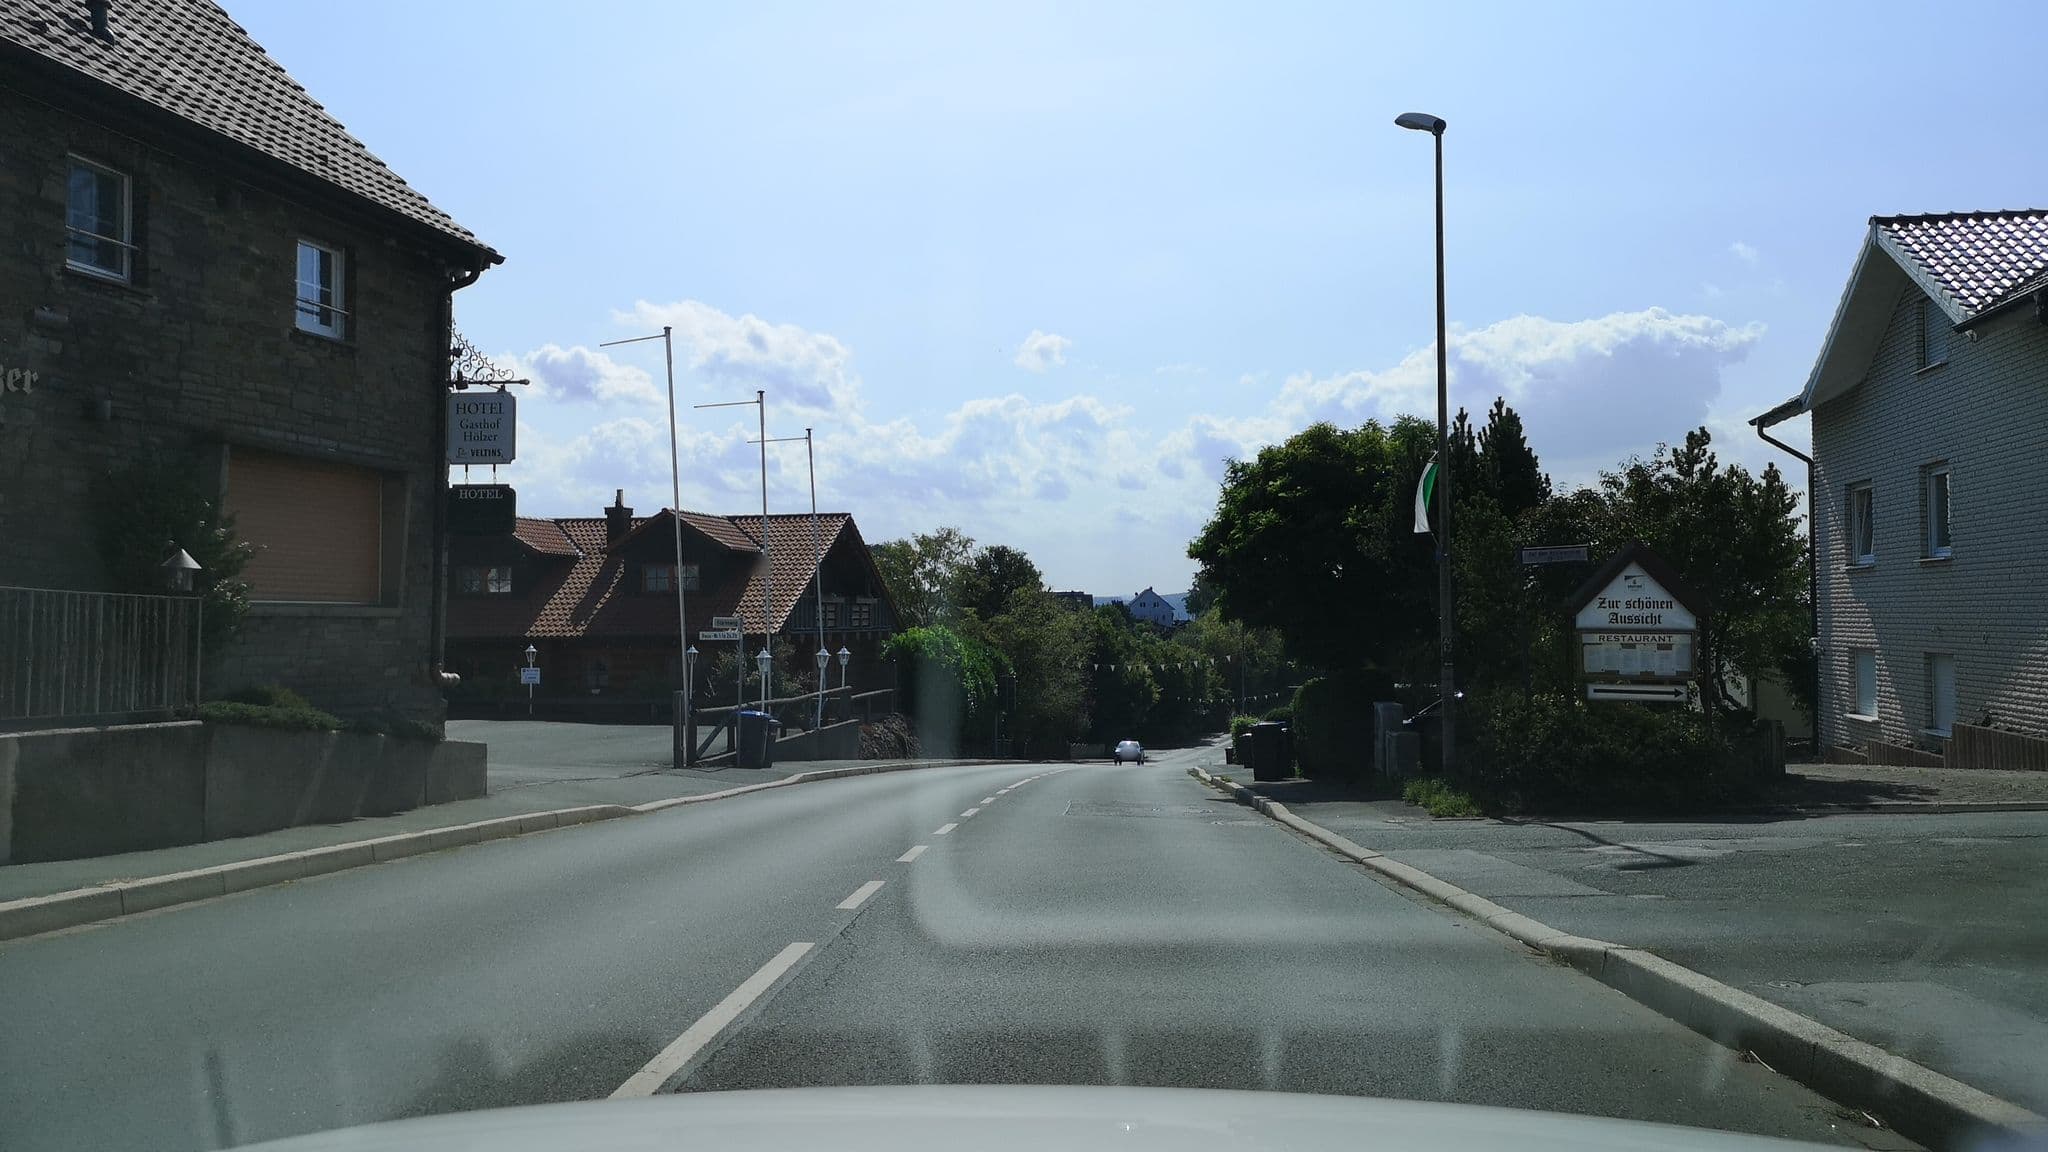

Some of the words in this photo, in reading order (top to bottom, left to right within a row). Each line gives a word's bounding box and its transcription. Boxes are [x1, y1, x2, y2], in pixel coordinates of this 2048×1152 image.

[456, 402, 504, 415] HOTEL
[460, 418, 501, 430] Gasthof
[470, 448, 502, 457] VELTINS
[459, 488, 503, 499] HOTEL
[1597, 597, 1621, 609] Zur
[1625, 597, 1673, 611] schönen
[1608, 612, 1663, 626] Aussicht
[1598, 634, 1674, 643] RESTAURANT
